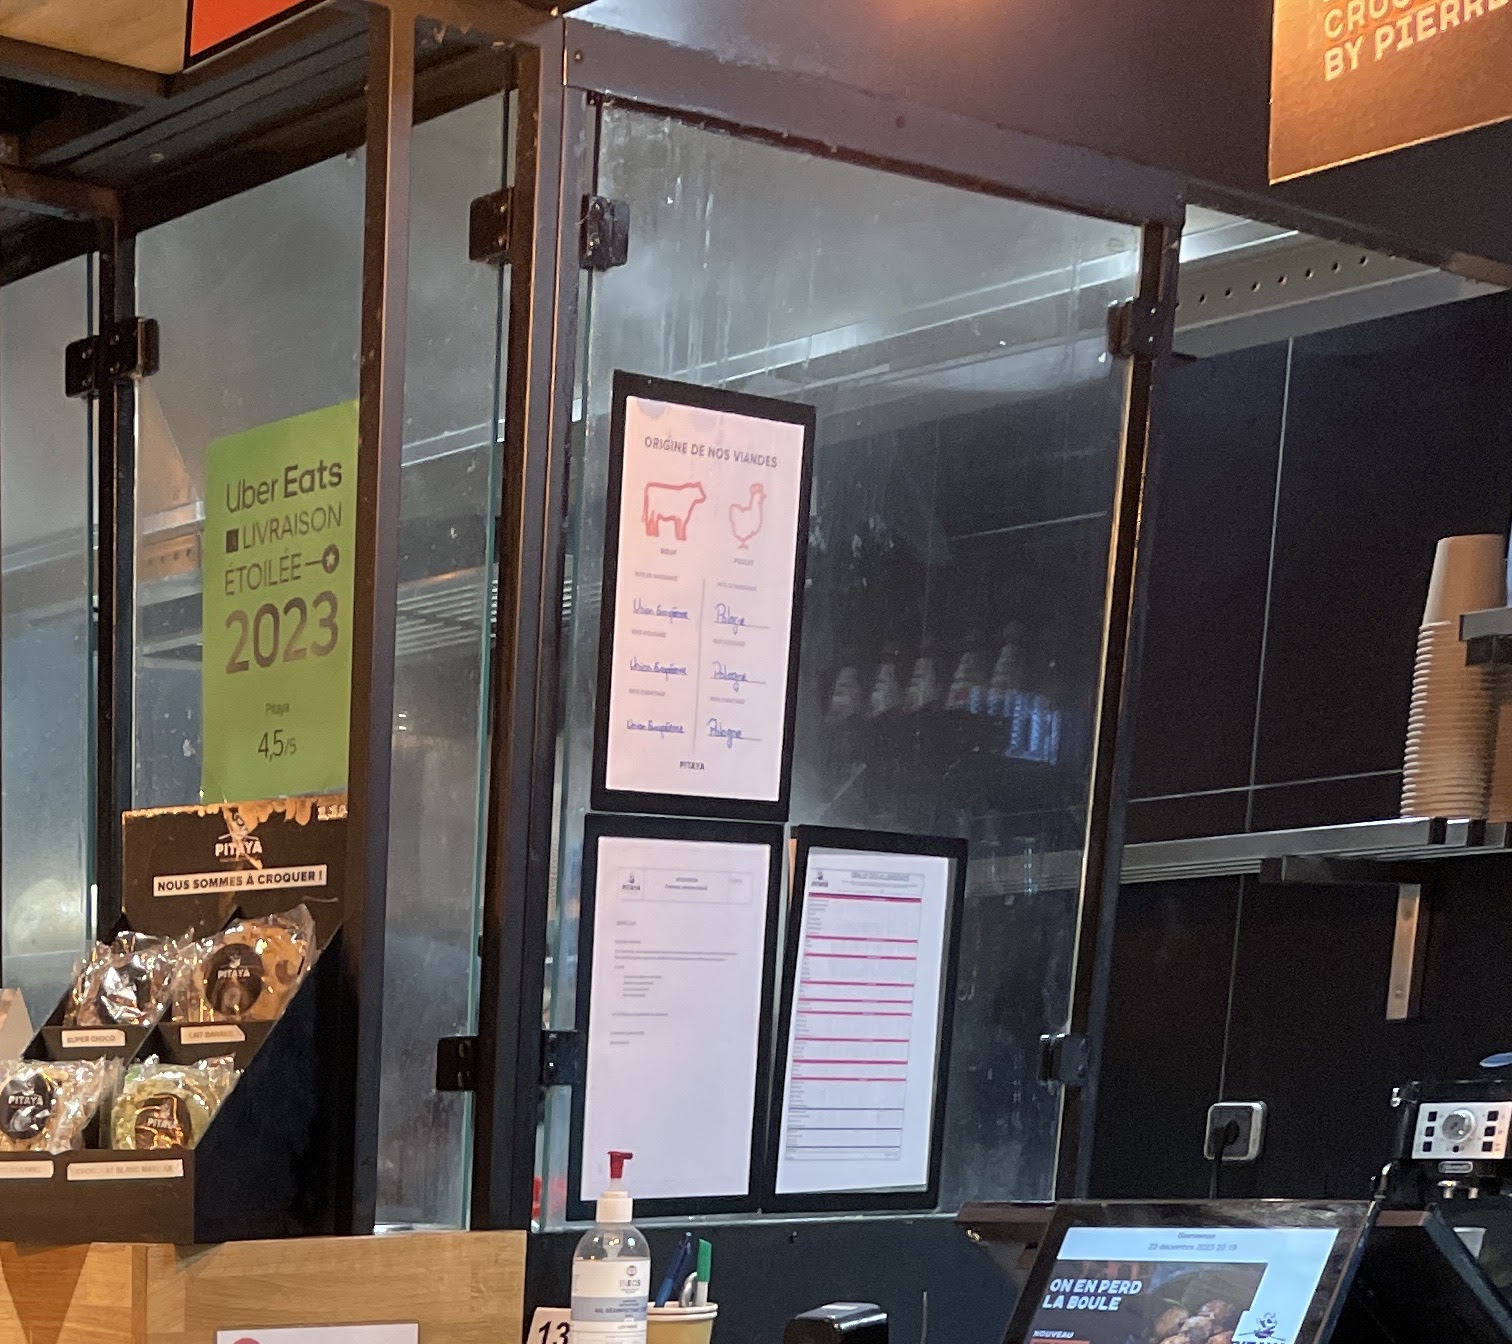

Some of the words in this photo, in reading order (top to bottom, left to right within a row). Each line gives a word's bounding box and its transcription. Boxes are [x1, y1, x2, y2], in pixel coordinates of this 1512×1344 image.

[1324, 35, 1364, 81] BY
[644, 436, 688, 454] ORIGINE
[690, 443, 705, 456] DE
[708, 446, 730, 460] NOS
[733, 450, 778, 468] VIANDES
[226, 479, 278, 513] Uber
[282, 459, 342, 499] Eats
[242, 503, 342, 550] LIVRAISON
[224, 547, 302, 596] ÉTOILÉE
[225, 590, 338, 675] 2023
[265, 702, 290, 717] Pitaya
[157, 880, 190, 892] NOUS
[193, 875, 243, 889] SOMMES
[246, 872, 255, 886] À
[257, 871, 315, 885] CROQUER
[217, 969, 251, 979] PITAYA
[7, 1095, 44, 1106] PITAYA
[1049, 1278, 1075, 1293] ON
[1076, 1279, 1099, 1293] EN
[1098, 1279, 1143, 1295] PERD
[1042, 1294, 1063, 1309] LA
[1065, 1295, 1122, 1311] BOULE
[1032, 1330, 1075, 1339] NOUVEAU
